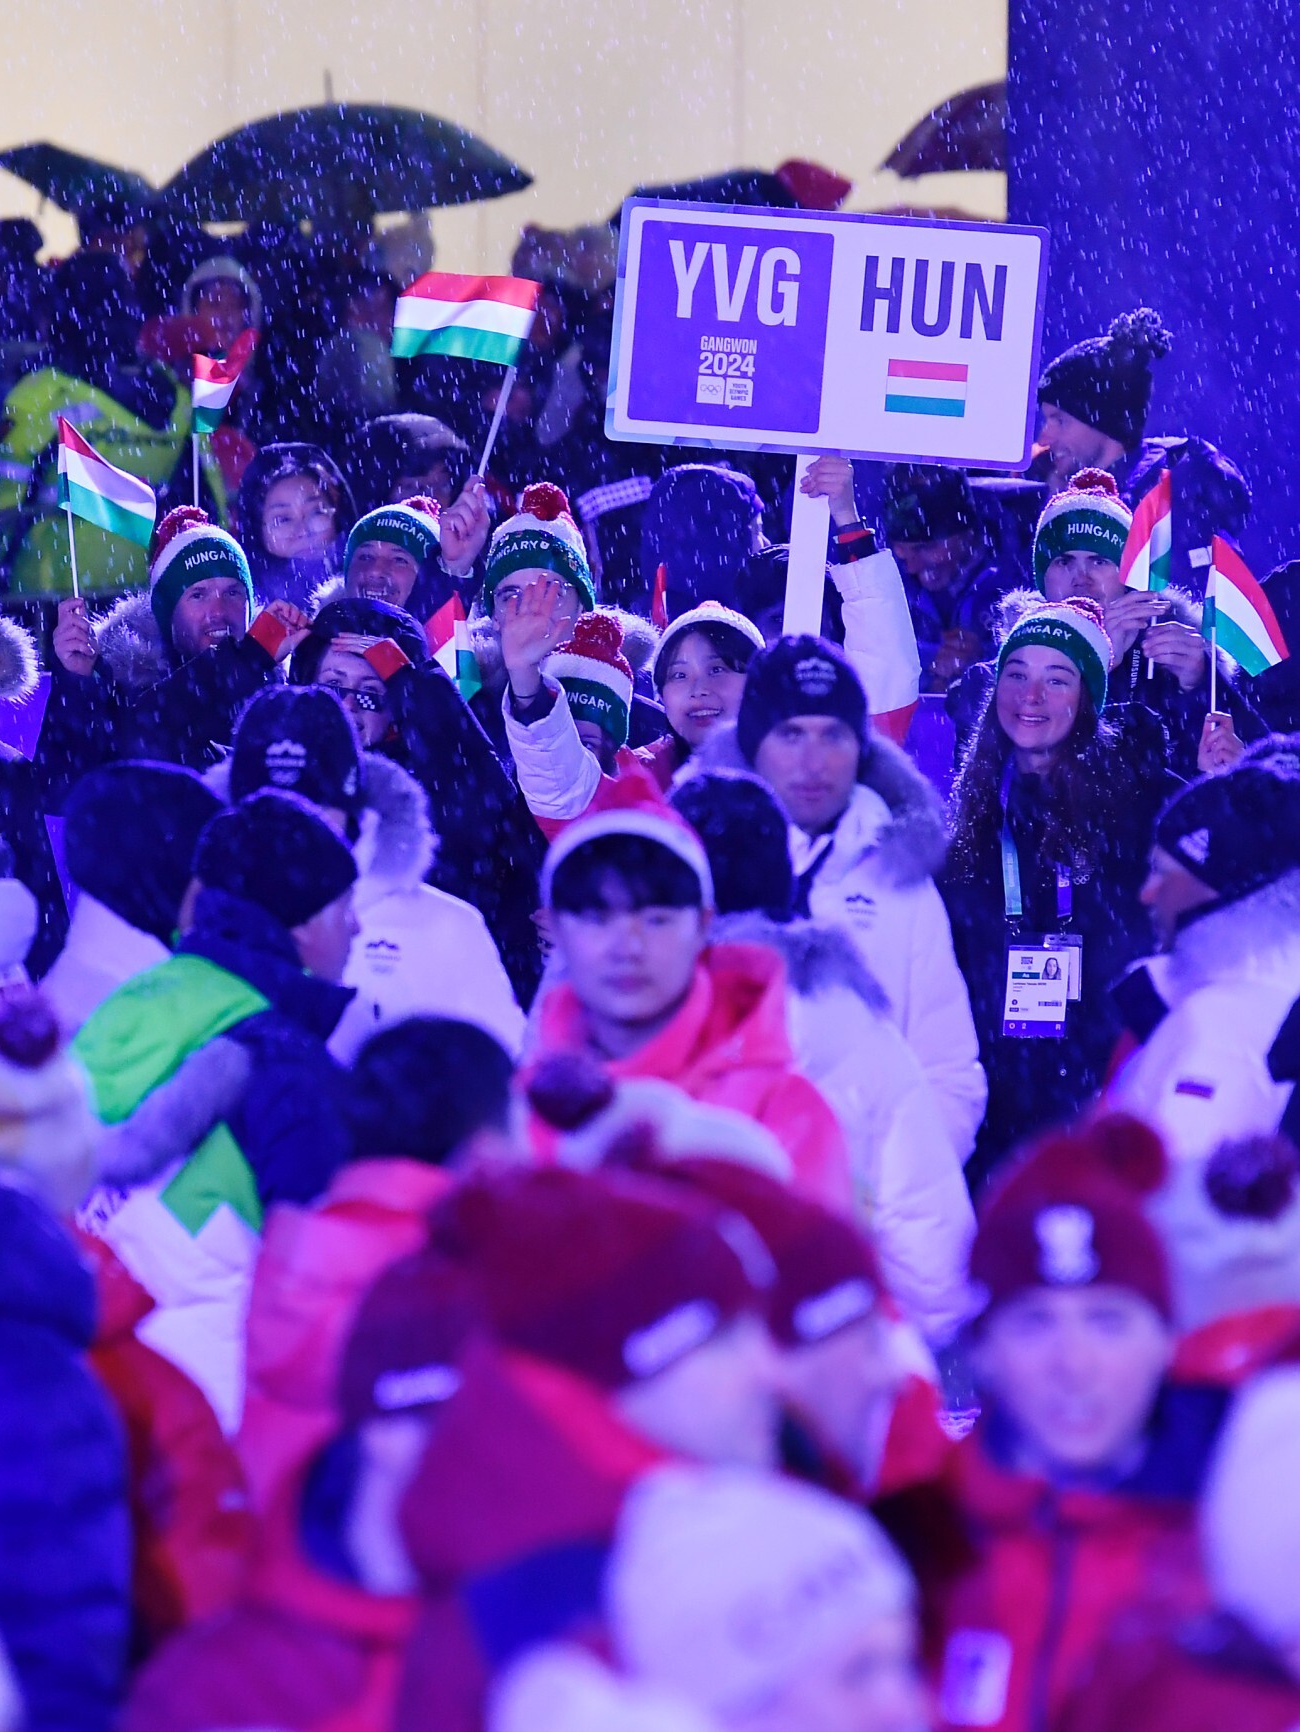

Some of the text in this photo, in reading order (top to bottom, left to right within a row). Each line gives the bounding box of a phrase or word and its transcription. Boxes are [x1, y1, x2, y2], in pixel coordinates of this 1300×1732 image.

[668, 239, 802, 327] YVG
[860, 255, 1008, 341] HUN
[700, 335, 757, 354] GANGWON
[698, 351, 755, 377] 2024
[376, 518, 430, 558] HUNGARY
[1067, 523, 1125, 550] HUNGARY
[184, 550, 236, 571] HUNGAR
[490, 540, 539, 567] NGARY
[1013, 625, 1072, 641] NGARY
[566, 691, 612, 713] NGARY
